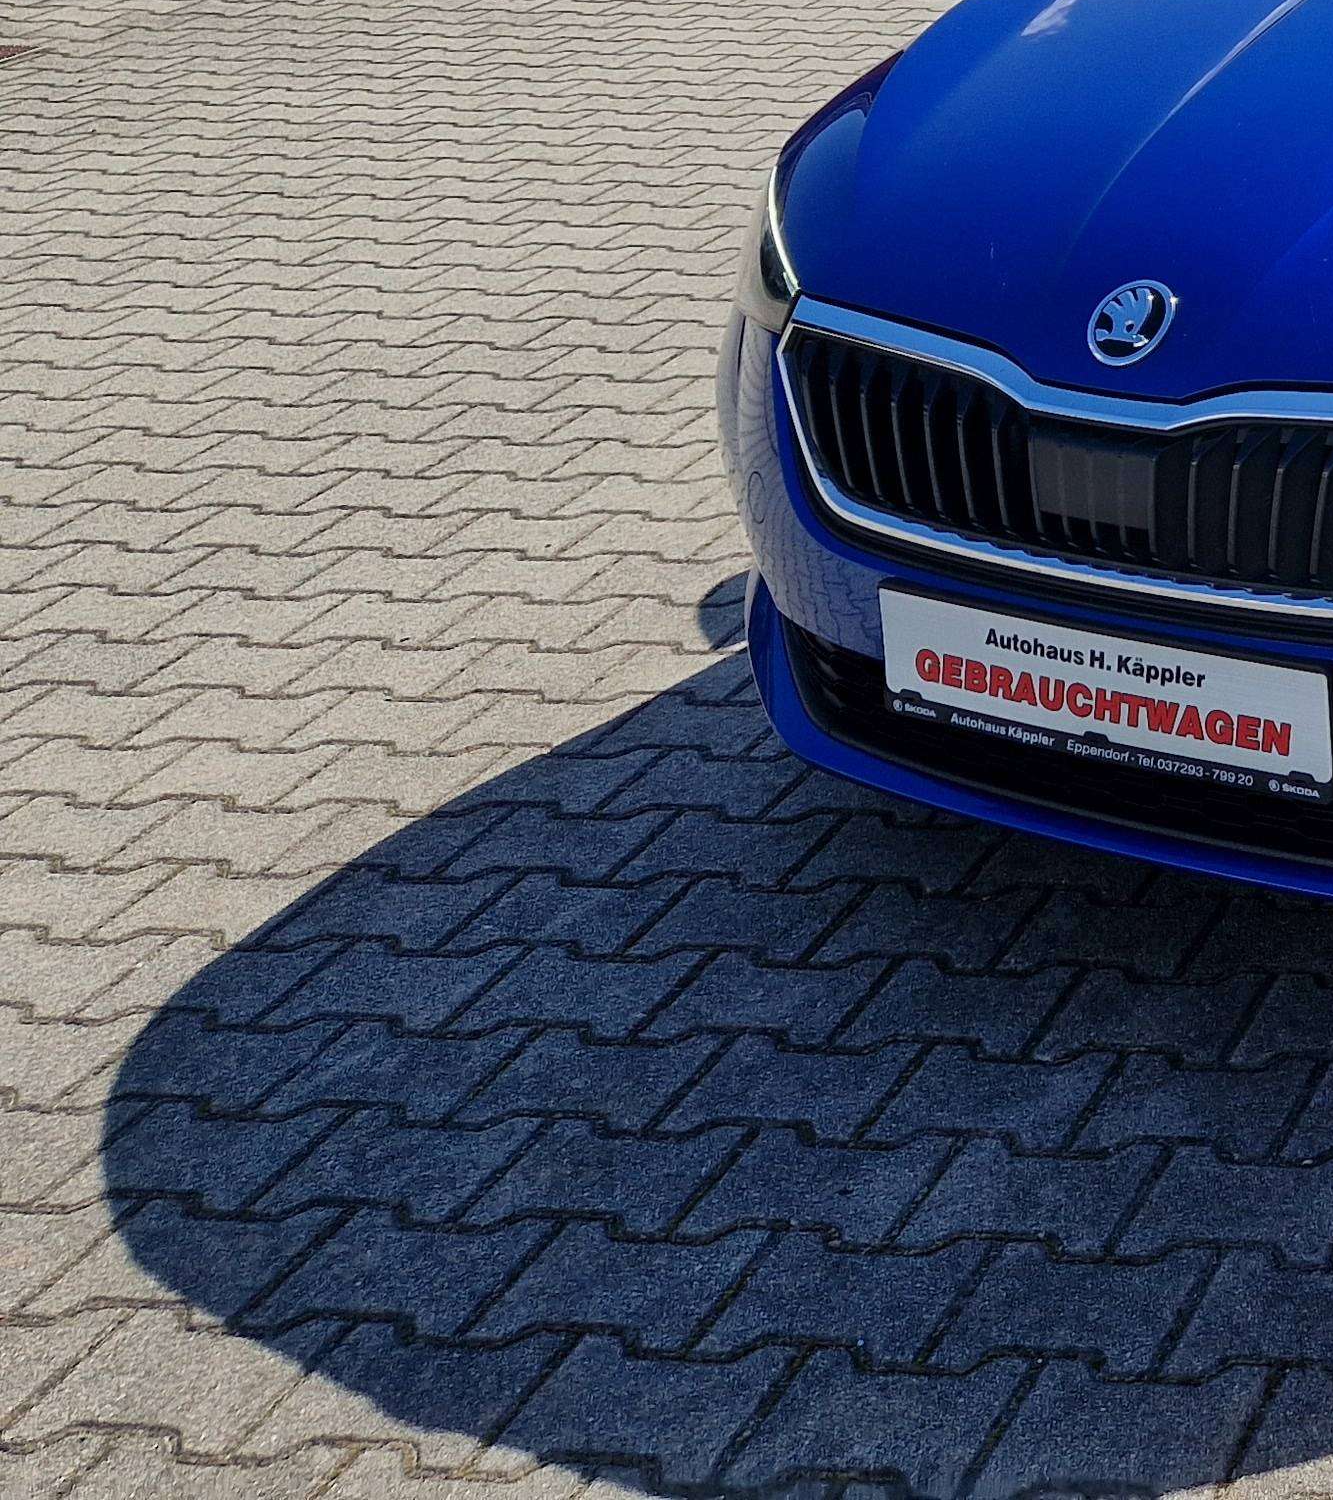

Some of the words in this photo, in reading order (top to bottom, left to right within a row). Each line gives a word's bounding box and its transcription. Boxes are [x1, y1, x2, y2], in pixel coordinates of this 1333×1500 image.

[985, 628, 1085, 666] Autohaus
[1089, 649, 1112, 671] H.
[1117, 654, 1206, 688] Käppler
[915, 647, 1292, 757] GEBRAUCHTWAGEN
[950, 712, 1007, 736] Autohaus
[1007, 726, 1056, 748] Käppler
[1066, 739, 1130, 764] Eppendorf
